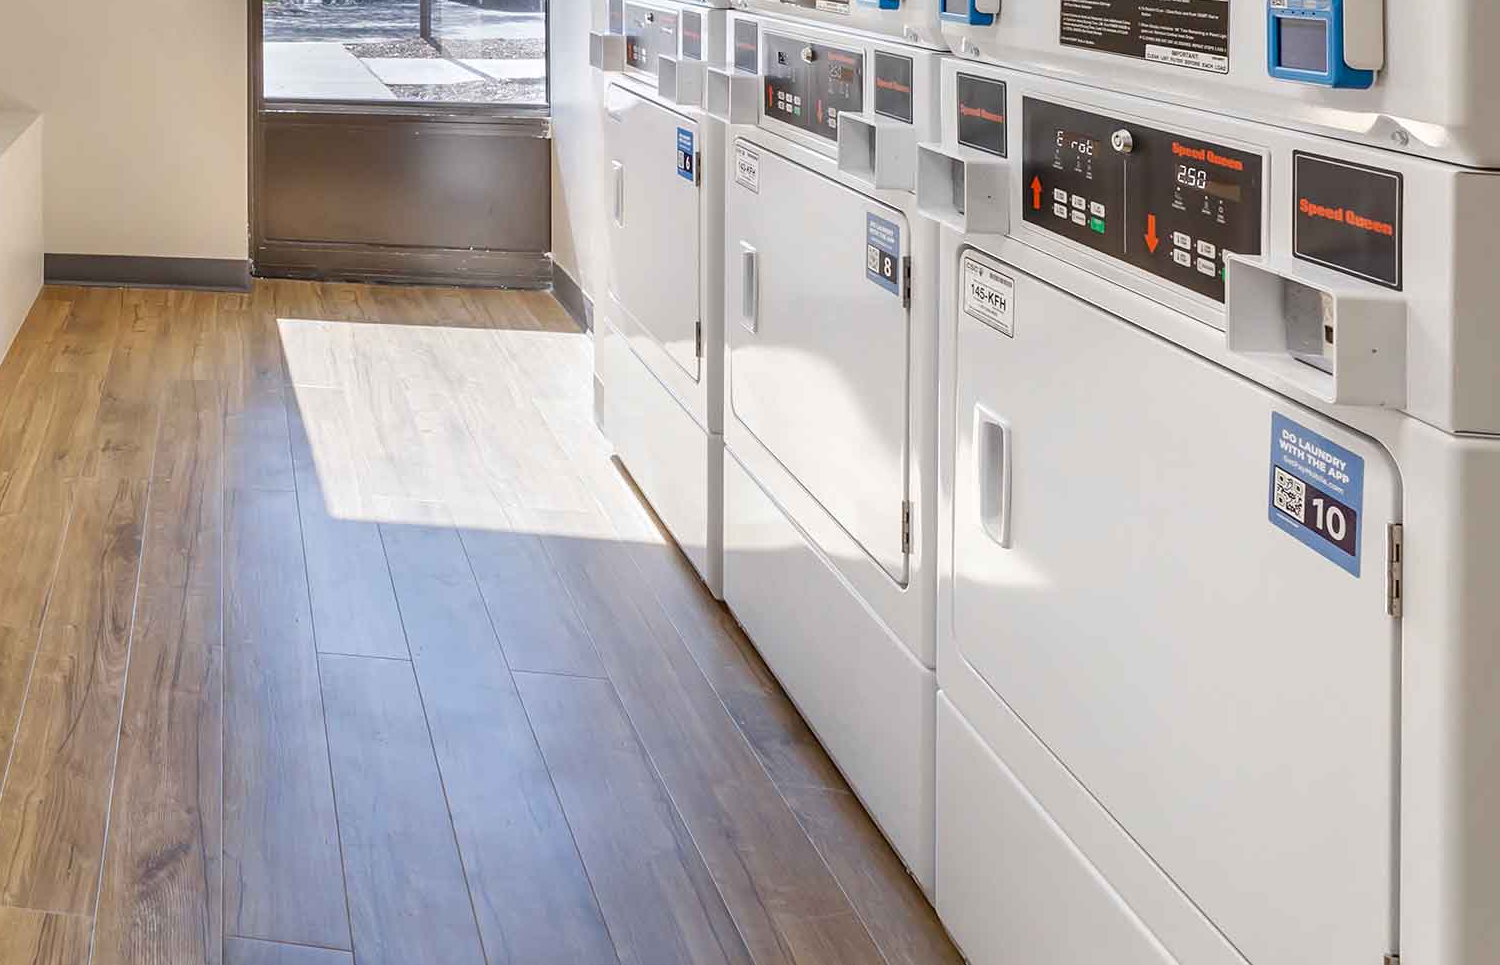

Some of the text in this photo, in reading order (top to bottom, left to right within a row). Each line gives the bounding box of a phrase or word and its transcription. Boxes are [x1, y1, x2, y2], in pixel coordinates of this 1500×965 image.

[686, 156, 691, 170] 6
[1172, 142, 1244, 170] Speed Queen
[1178, 165, 1206, 189] 2.50
[1300, 198, 1393, 236] Speed Queen
[884, 257, 892, 277] 8
[971, 283, 1006, 311] 145-KFH
[1279, 439, 1350, 484] WITH THE APP
[1282, 429, 1347, 470] DO LAUNDRY
[1312, 497, 1346, 541] 10
